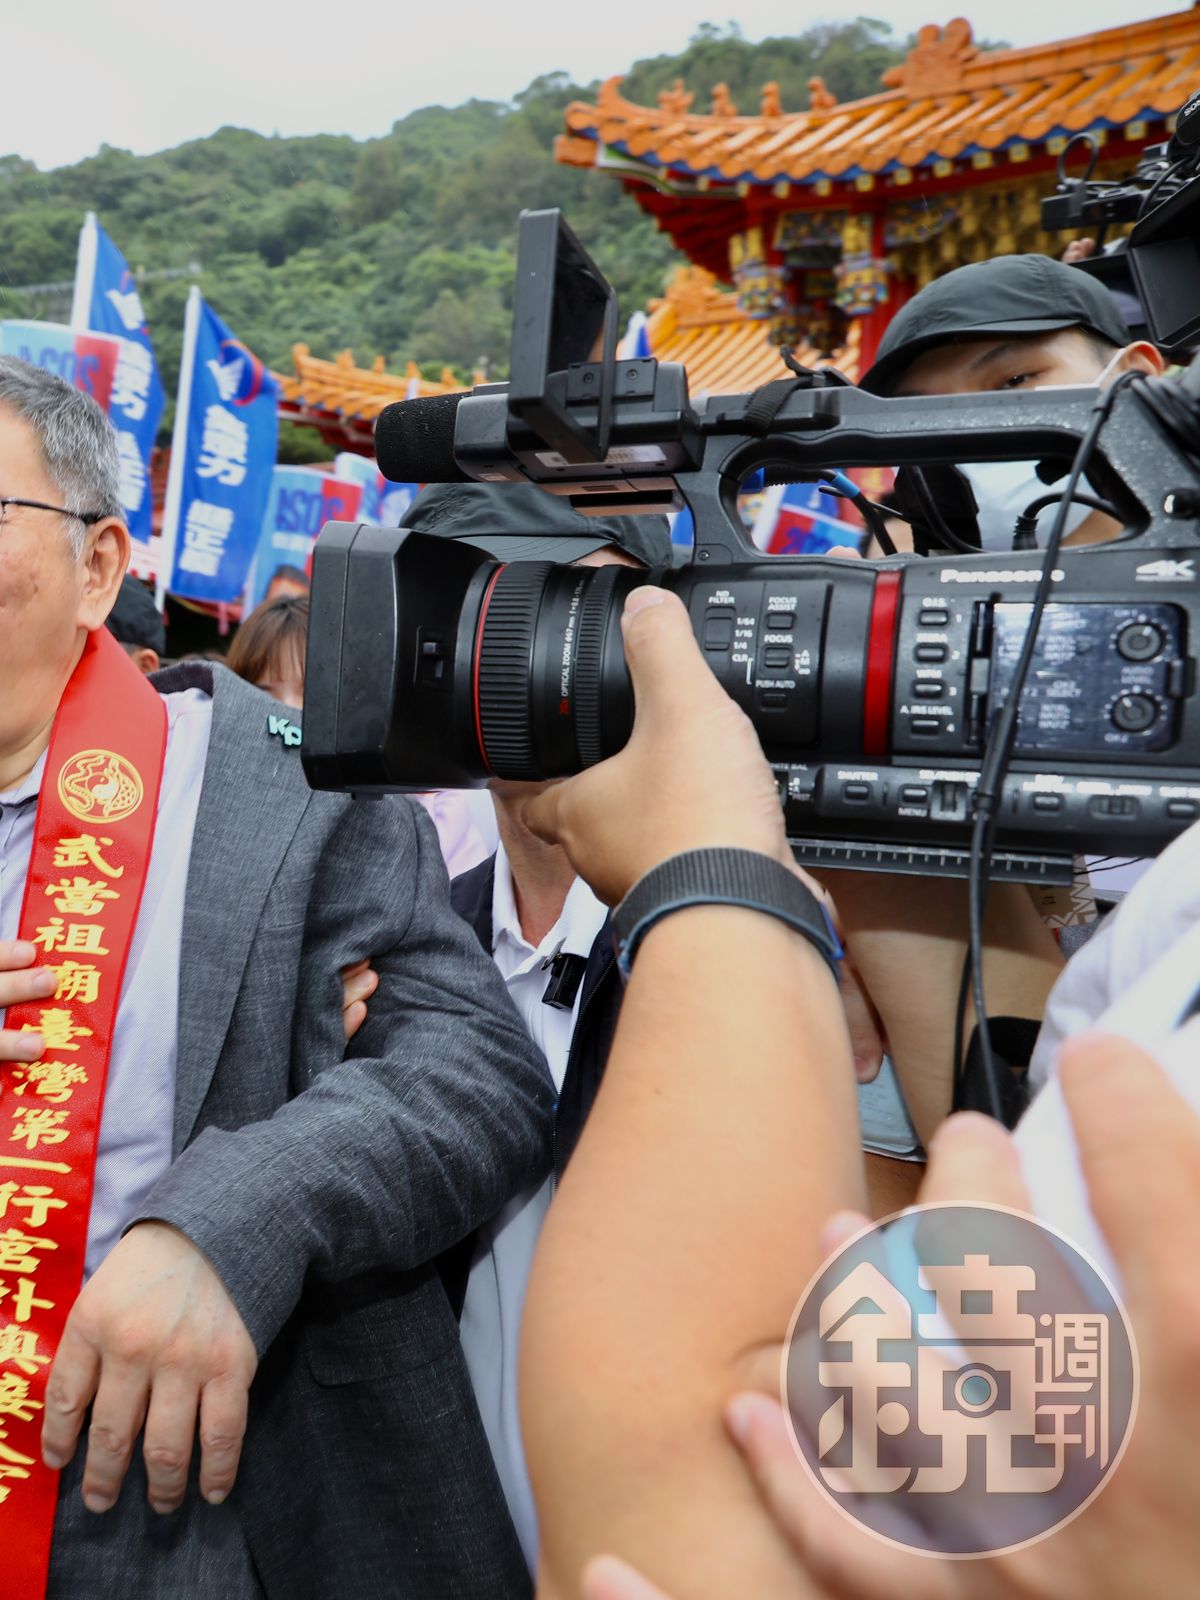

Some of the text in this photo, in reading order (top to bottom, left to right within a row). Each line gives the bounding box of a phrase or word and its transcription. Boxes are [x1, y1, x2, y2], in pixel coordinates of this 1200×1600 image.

[1184, 100, 1200, 117] SO
[1136, 560, 1195, 576] 4K
[940, 569, 1065, 583] Panasonc
[708, 596, 735, 604] FILTER
[768, 596, 797, 604] FOCUS
[767, 603, 796, 611] ASSIST
[763, 634, 793, 643] FOCUS
[562, 643, 572, 666] ZOOM
[561, 667, 570, 697] OPTICAL
[755, 680, 796, 689] PUSH AUTO
[927, 705, 954, 716] LEVEL
[838, 771, 879, 781] SHUTTER
[898, 807, 928, 817] MENU
